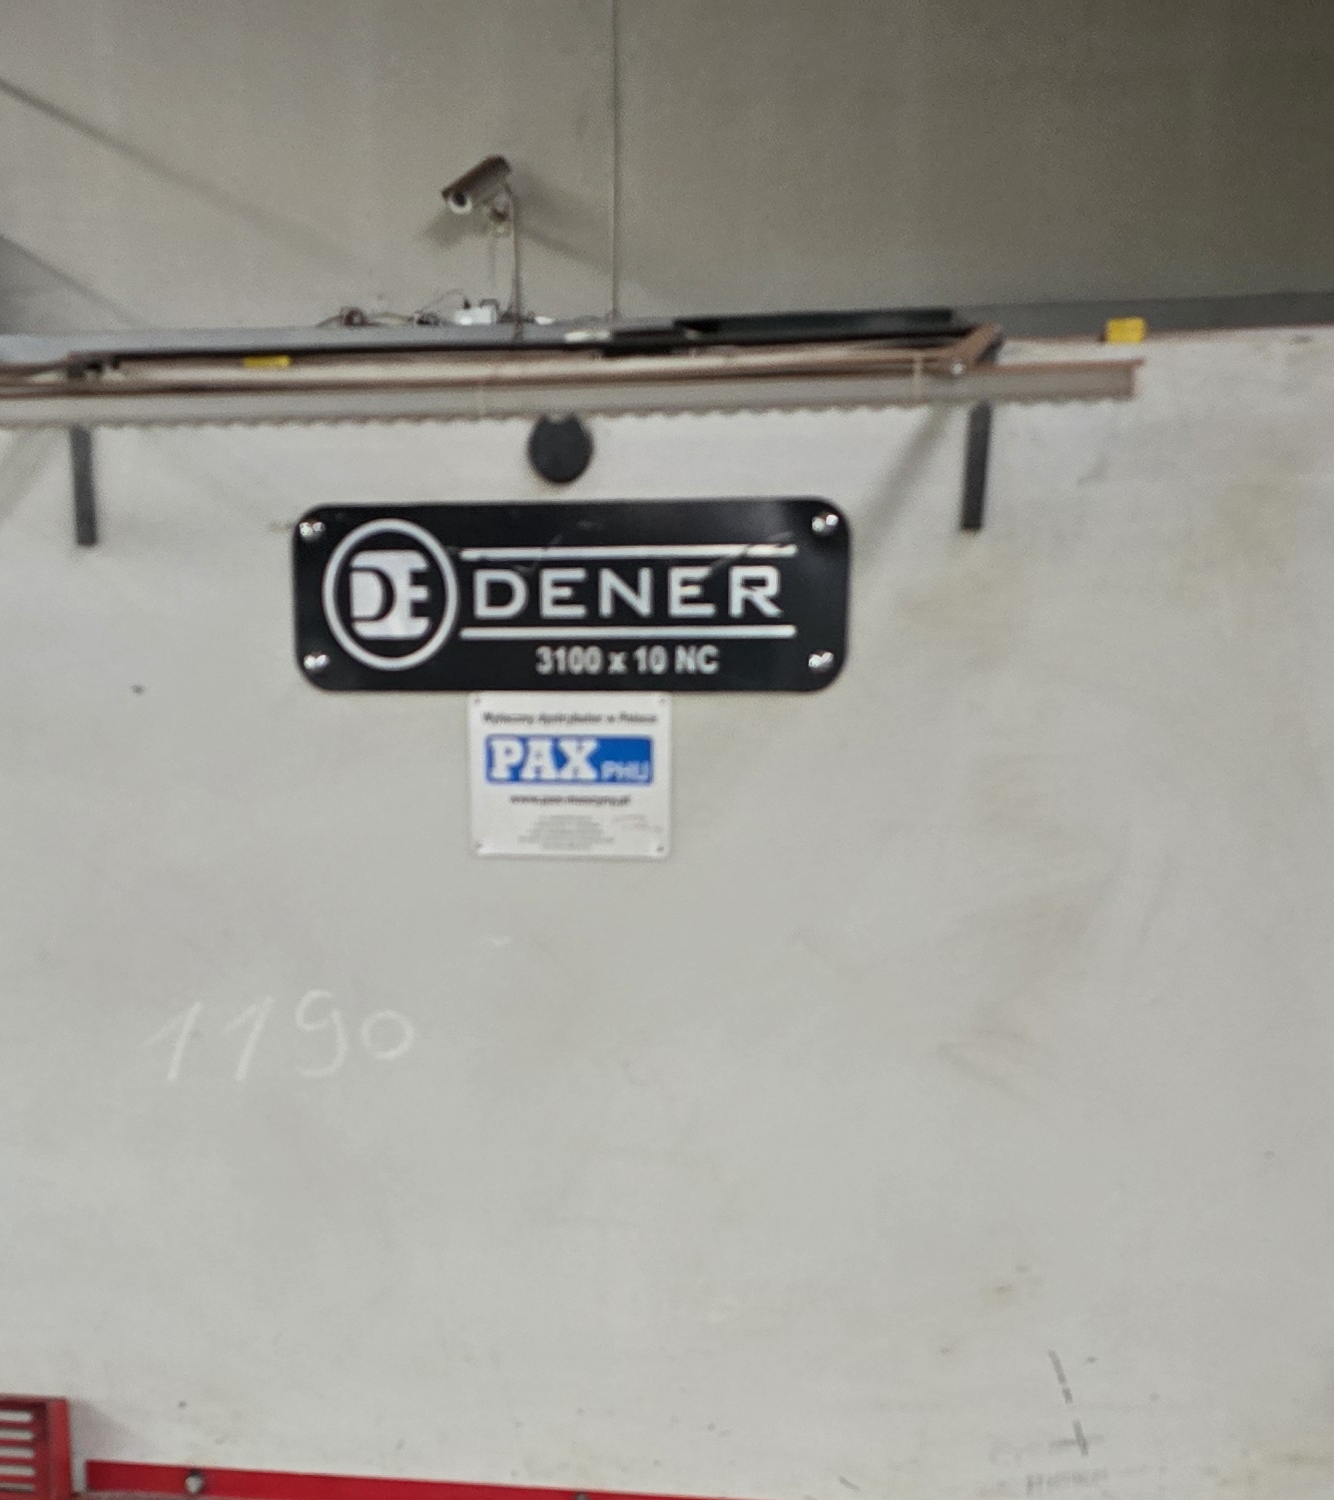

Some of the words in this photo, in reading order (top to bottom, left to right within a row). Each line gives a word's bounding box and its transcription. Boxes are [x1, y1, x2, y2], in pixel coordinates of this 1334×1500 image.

[473, 565, 783, 619] DENER
[535, 644, 604, 675] 3100
[607, 651, 627, 675] x
[634, 644, 667, 675] 10
[674, 644, 719, 675] NC
[490, 739, 599, 780] PAX
[600, 760, 650, 781] PHU
[140, 988, 415, 1082] 1190
